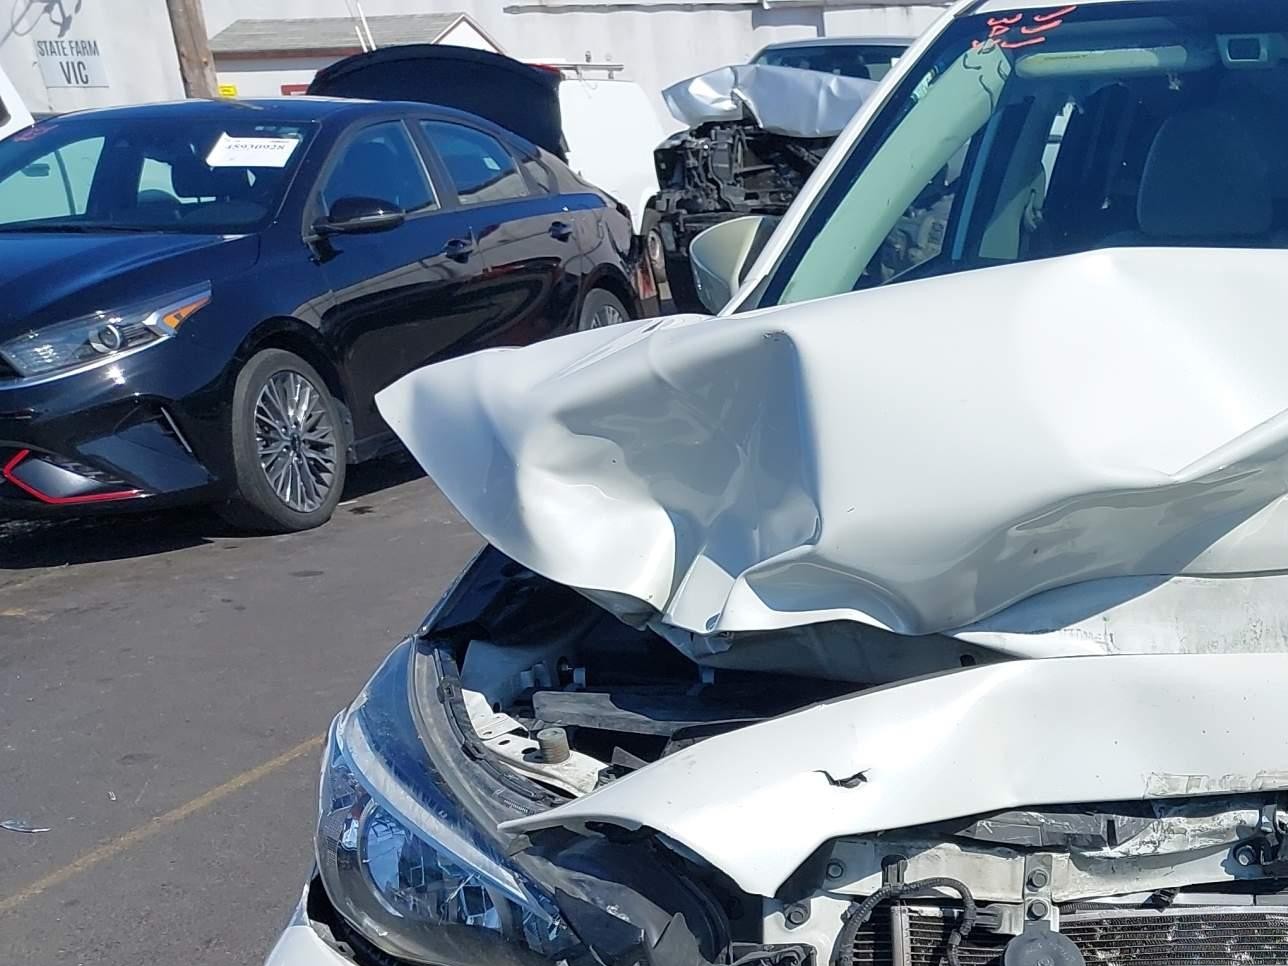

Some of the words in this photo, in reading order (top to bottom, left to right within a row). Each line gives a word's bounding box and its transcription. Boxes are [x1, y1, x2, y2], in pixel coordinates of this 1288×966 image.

[37, 40, 68, 56] STATE
[69, 40, 100, 56] FARM
[59, 60, 89, 85] VIC
